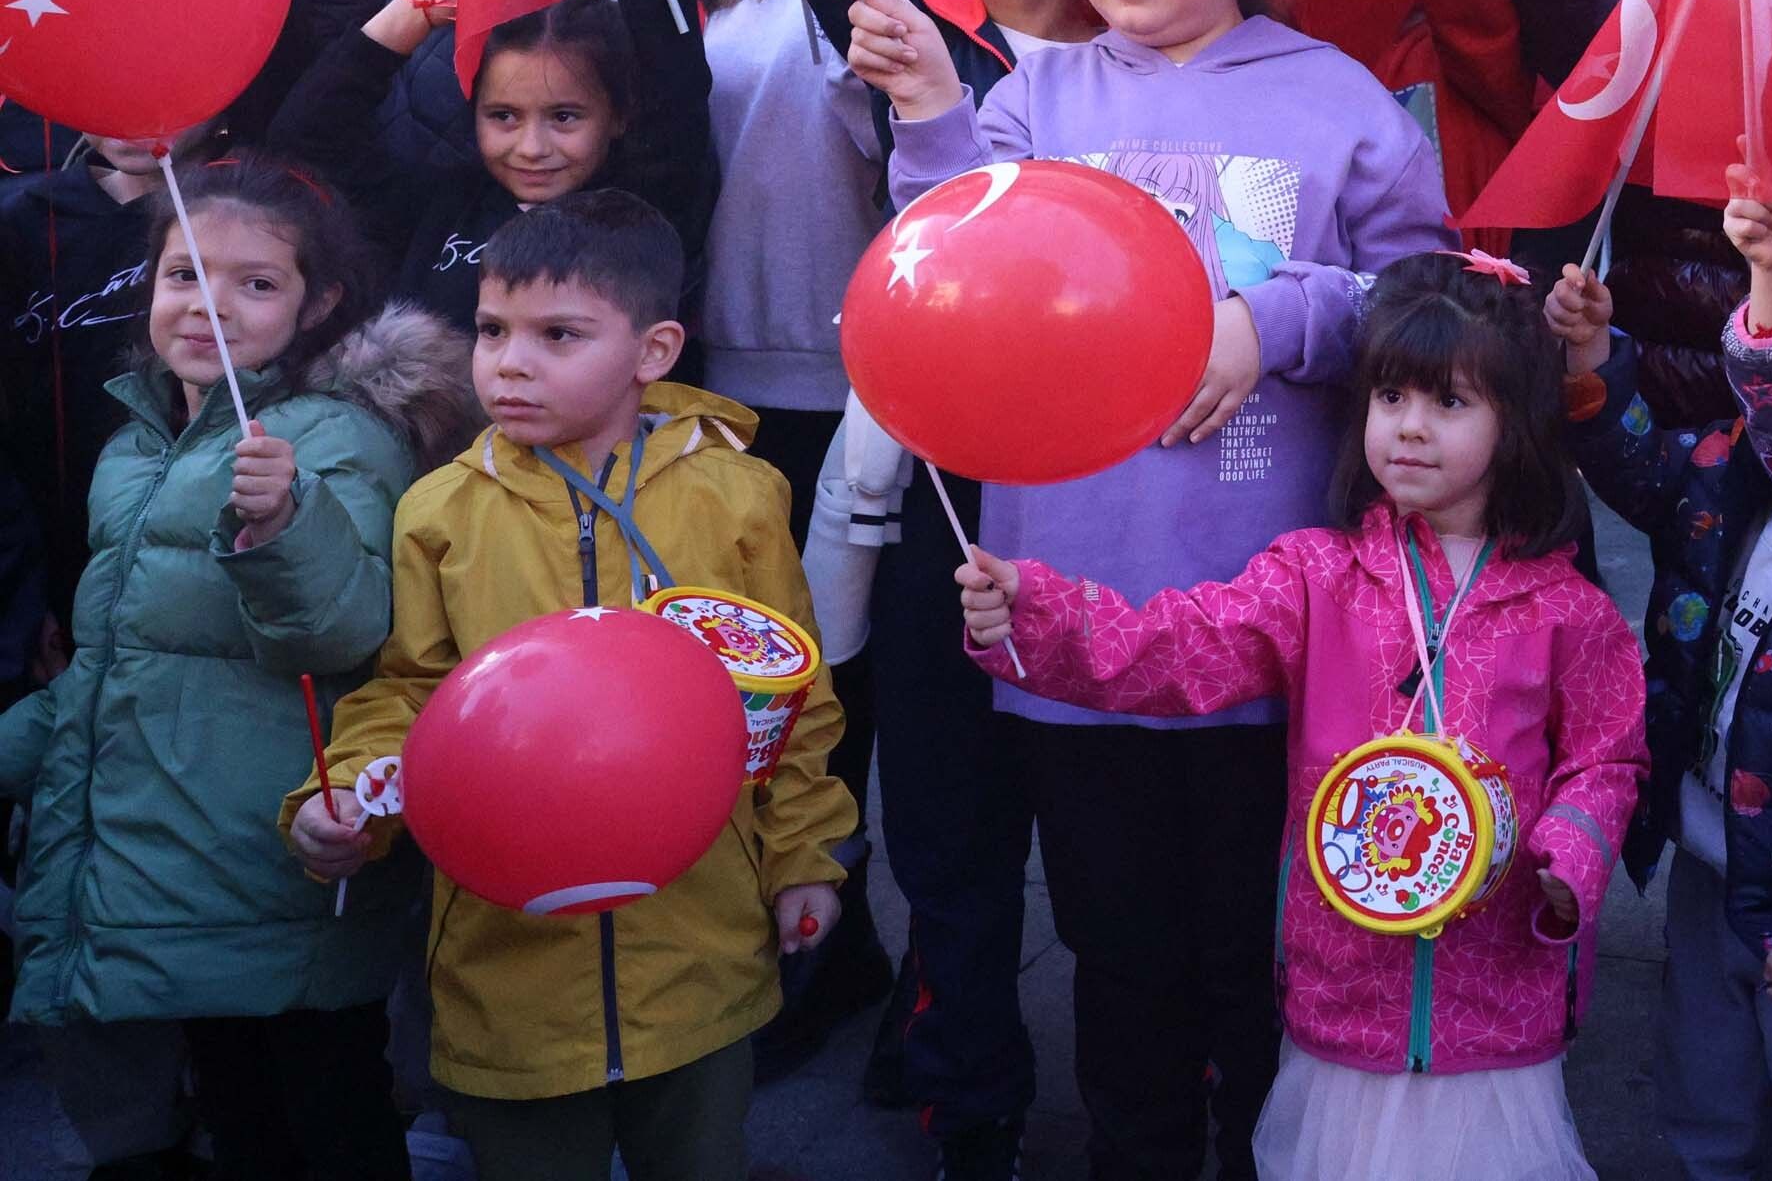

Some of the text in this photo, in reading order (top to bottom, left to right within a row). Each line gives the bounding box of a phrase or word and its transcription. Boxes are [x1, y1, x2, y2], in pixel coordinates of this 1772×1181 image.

[1235, 415, 1258, 425] KIND
[1260, 414, 1277, 424] AND
[1221, 426, 1266, 437] TRUTHFUL
[1220, 437, 1255, 448] THAT IS
[1220, 447, 1272, 459] THE SECRET
[1220, 460, 1231, 470] TO
[1267, 458, 1272, 468] A
[1366, 758, 1428, 772] MUSICAL PARTY
[1413, 812, 1461, 895] Concert
[1436, 831, 1475, 893] Baby
